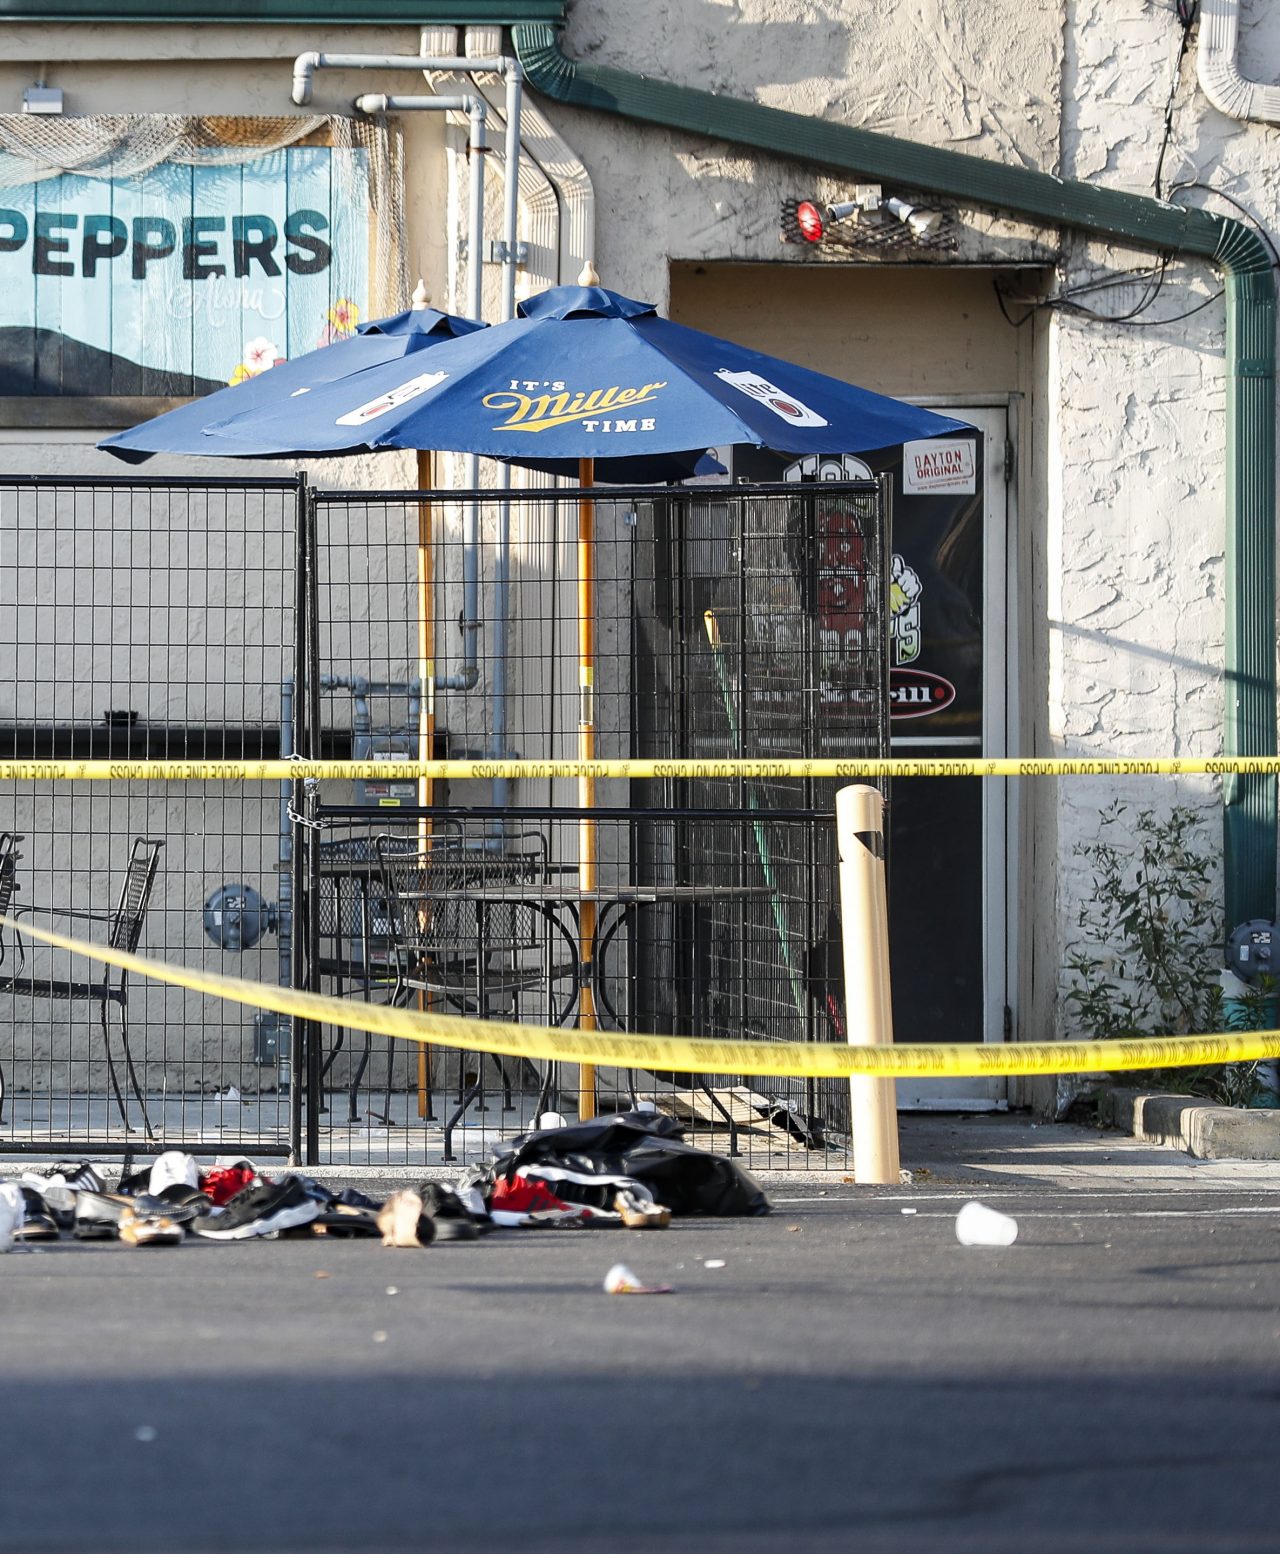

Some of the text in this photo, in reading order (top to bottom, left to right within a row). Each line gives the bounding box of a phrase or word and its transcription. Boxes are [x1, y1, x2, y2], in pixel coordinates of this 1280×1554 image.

[509, 379, 566, 392] IT'S
[482, 381, 668, 426] Miller
[581, 418, 656, 433] TIME
[914, 450, 962, 469] DAYTON
[917, 464, 963, 479] ORIGINAL
